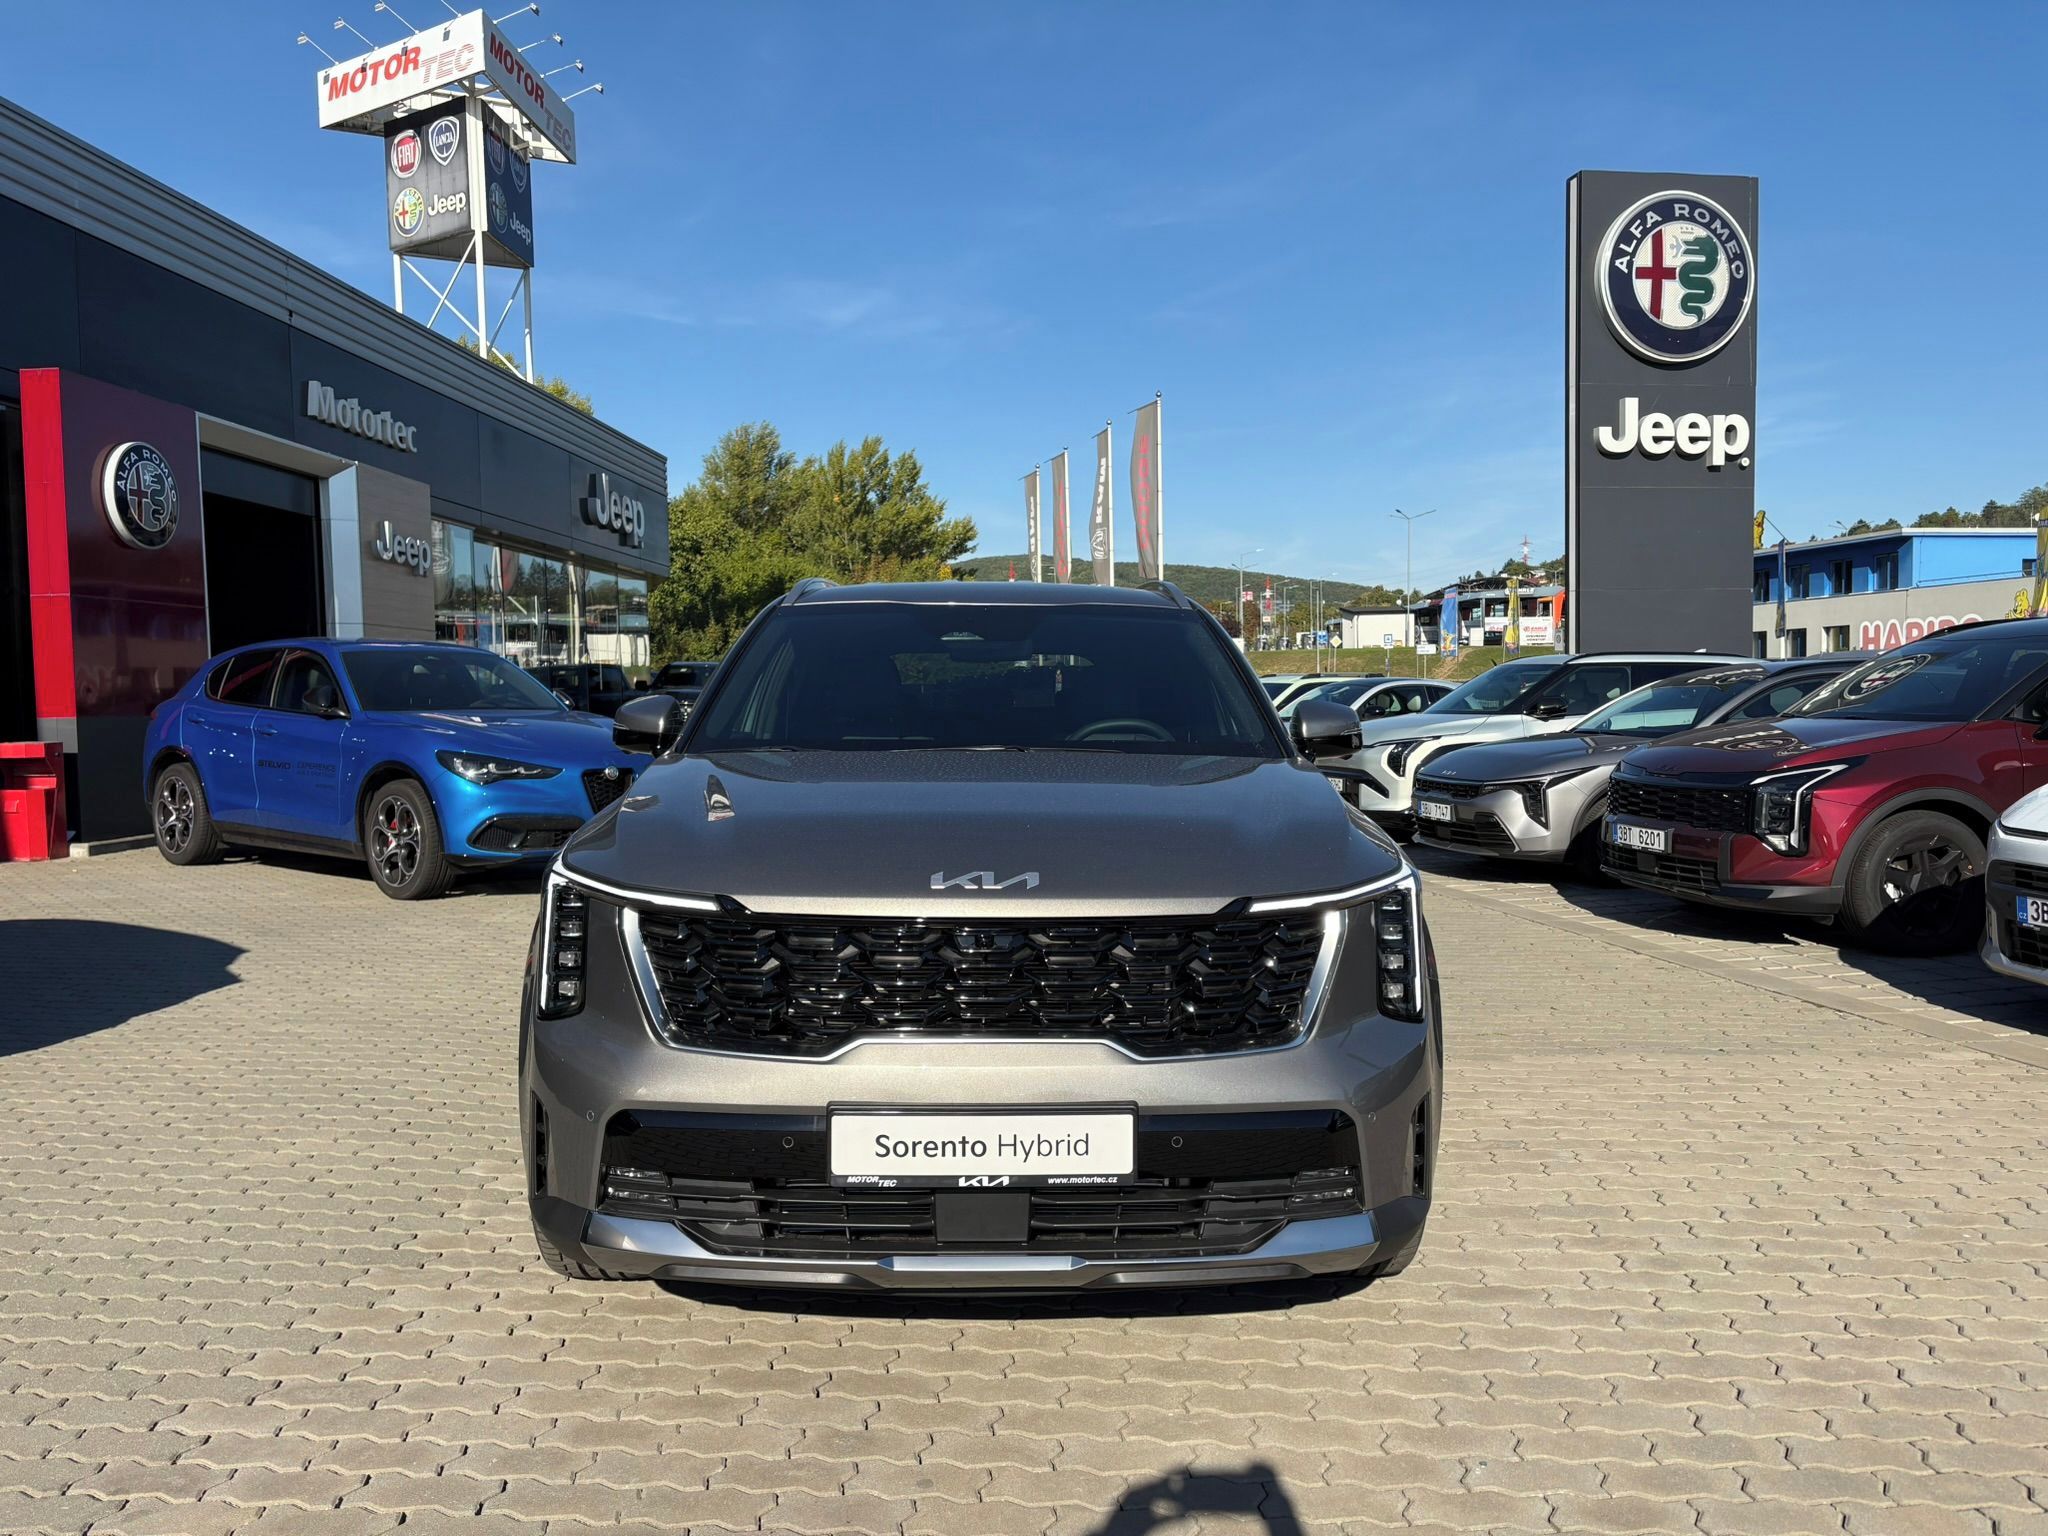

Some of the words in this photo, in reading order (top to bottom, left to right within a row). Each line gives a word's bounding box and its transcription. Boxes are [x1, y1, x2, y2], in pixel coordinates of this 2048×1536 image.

[327, 46, 421, 102] MOTOR
[420, 43, 475, 84] TEC
[489, 31, 545, 110] MOTOR
[397, 141, 415, 168] FIAT
[428, 192, 467, 216] Jeep
[509, 211, 532, 245] Jeep
[1614, 210, 1664, 274] ALFA
[1673, 203, 1745, 280] ROMEO
[308, 380, 418, 453] Motortec
[1596, 397, 1751, 467] Jeep
[117, 451, 139, 492] ALFA
[142, 448, 177, 502] ROMEO
[584, 472, 645, 548] Jeep
[376, 519, 433, 578] Jeep
[1618, 825, 1633, 843] 3BT
[1638, 829, 1662, 849] 6201
[875, 1134, 988, 1158] Sorento
[997, 1132, 1090, 1163] Hybrid
[847, 1175, 880, 1184] MOTOR
[878, 1179, 898, 1188] TEC
[1047, 1175, 1119, 1185] www.motortec.cz
